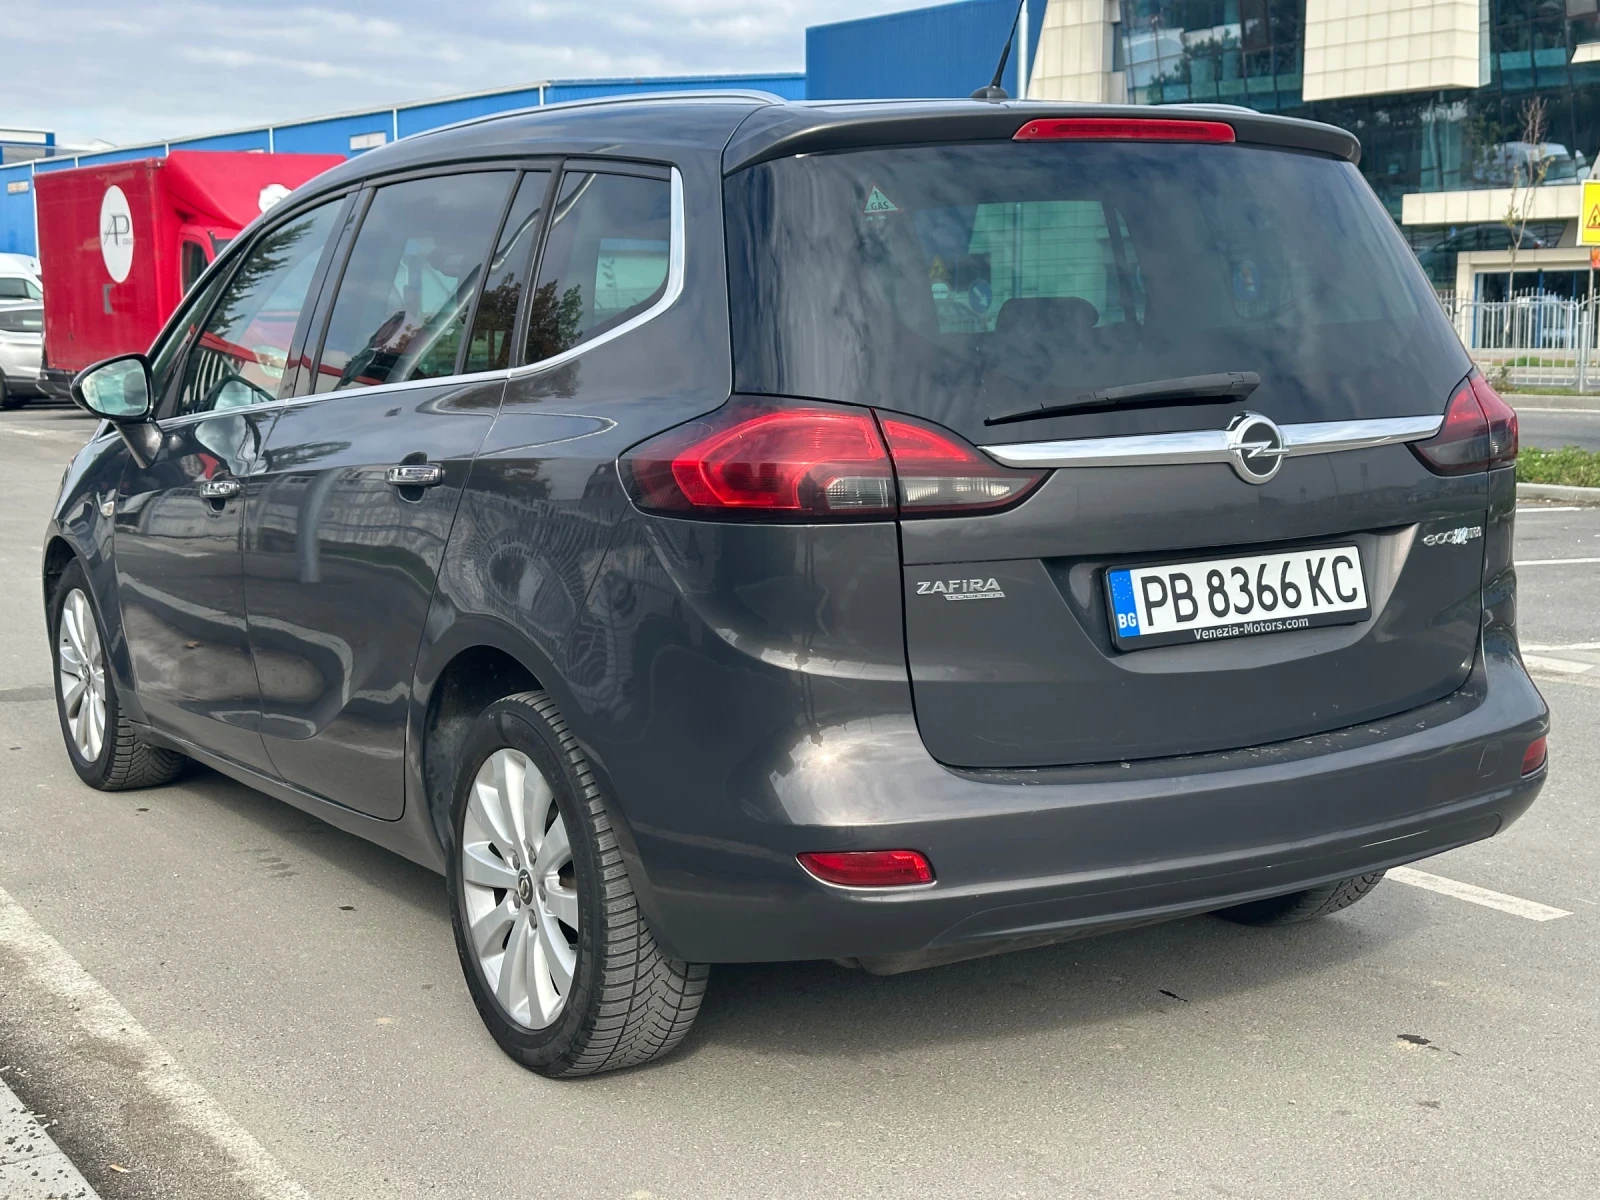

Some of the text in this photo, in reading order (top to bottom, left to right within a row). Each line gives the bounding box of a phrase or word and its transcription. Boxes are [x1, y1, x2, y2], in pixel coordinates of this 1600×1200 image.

[870, 201, 889, 211] GAS
[1140, 555, 1358, 627] PB 8366 KC
[1117, 612, 1137, 629] BG
[1194, 617, 1309, 640] Venezia-Motors.com
